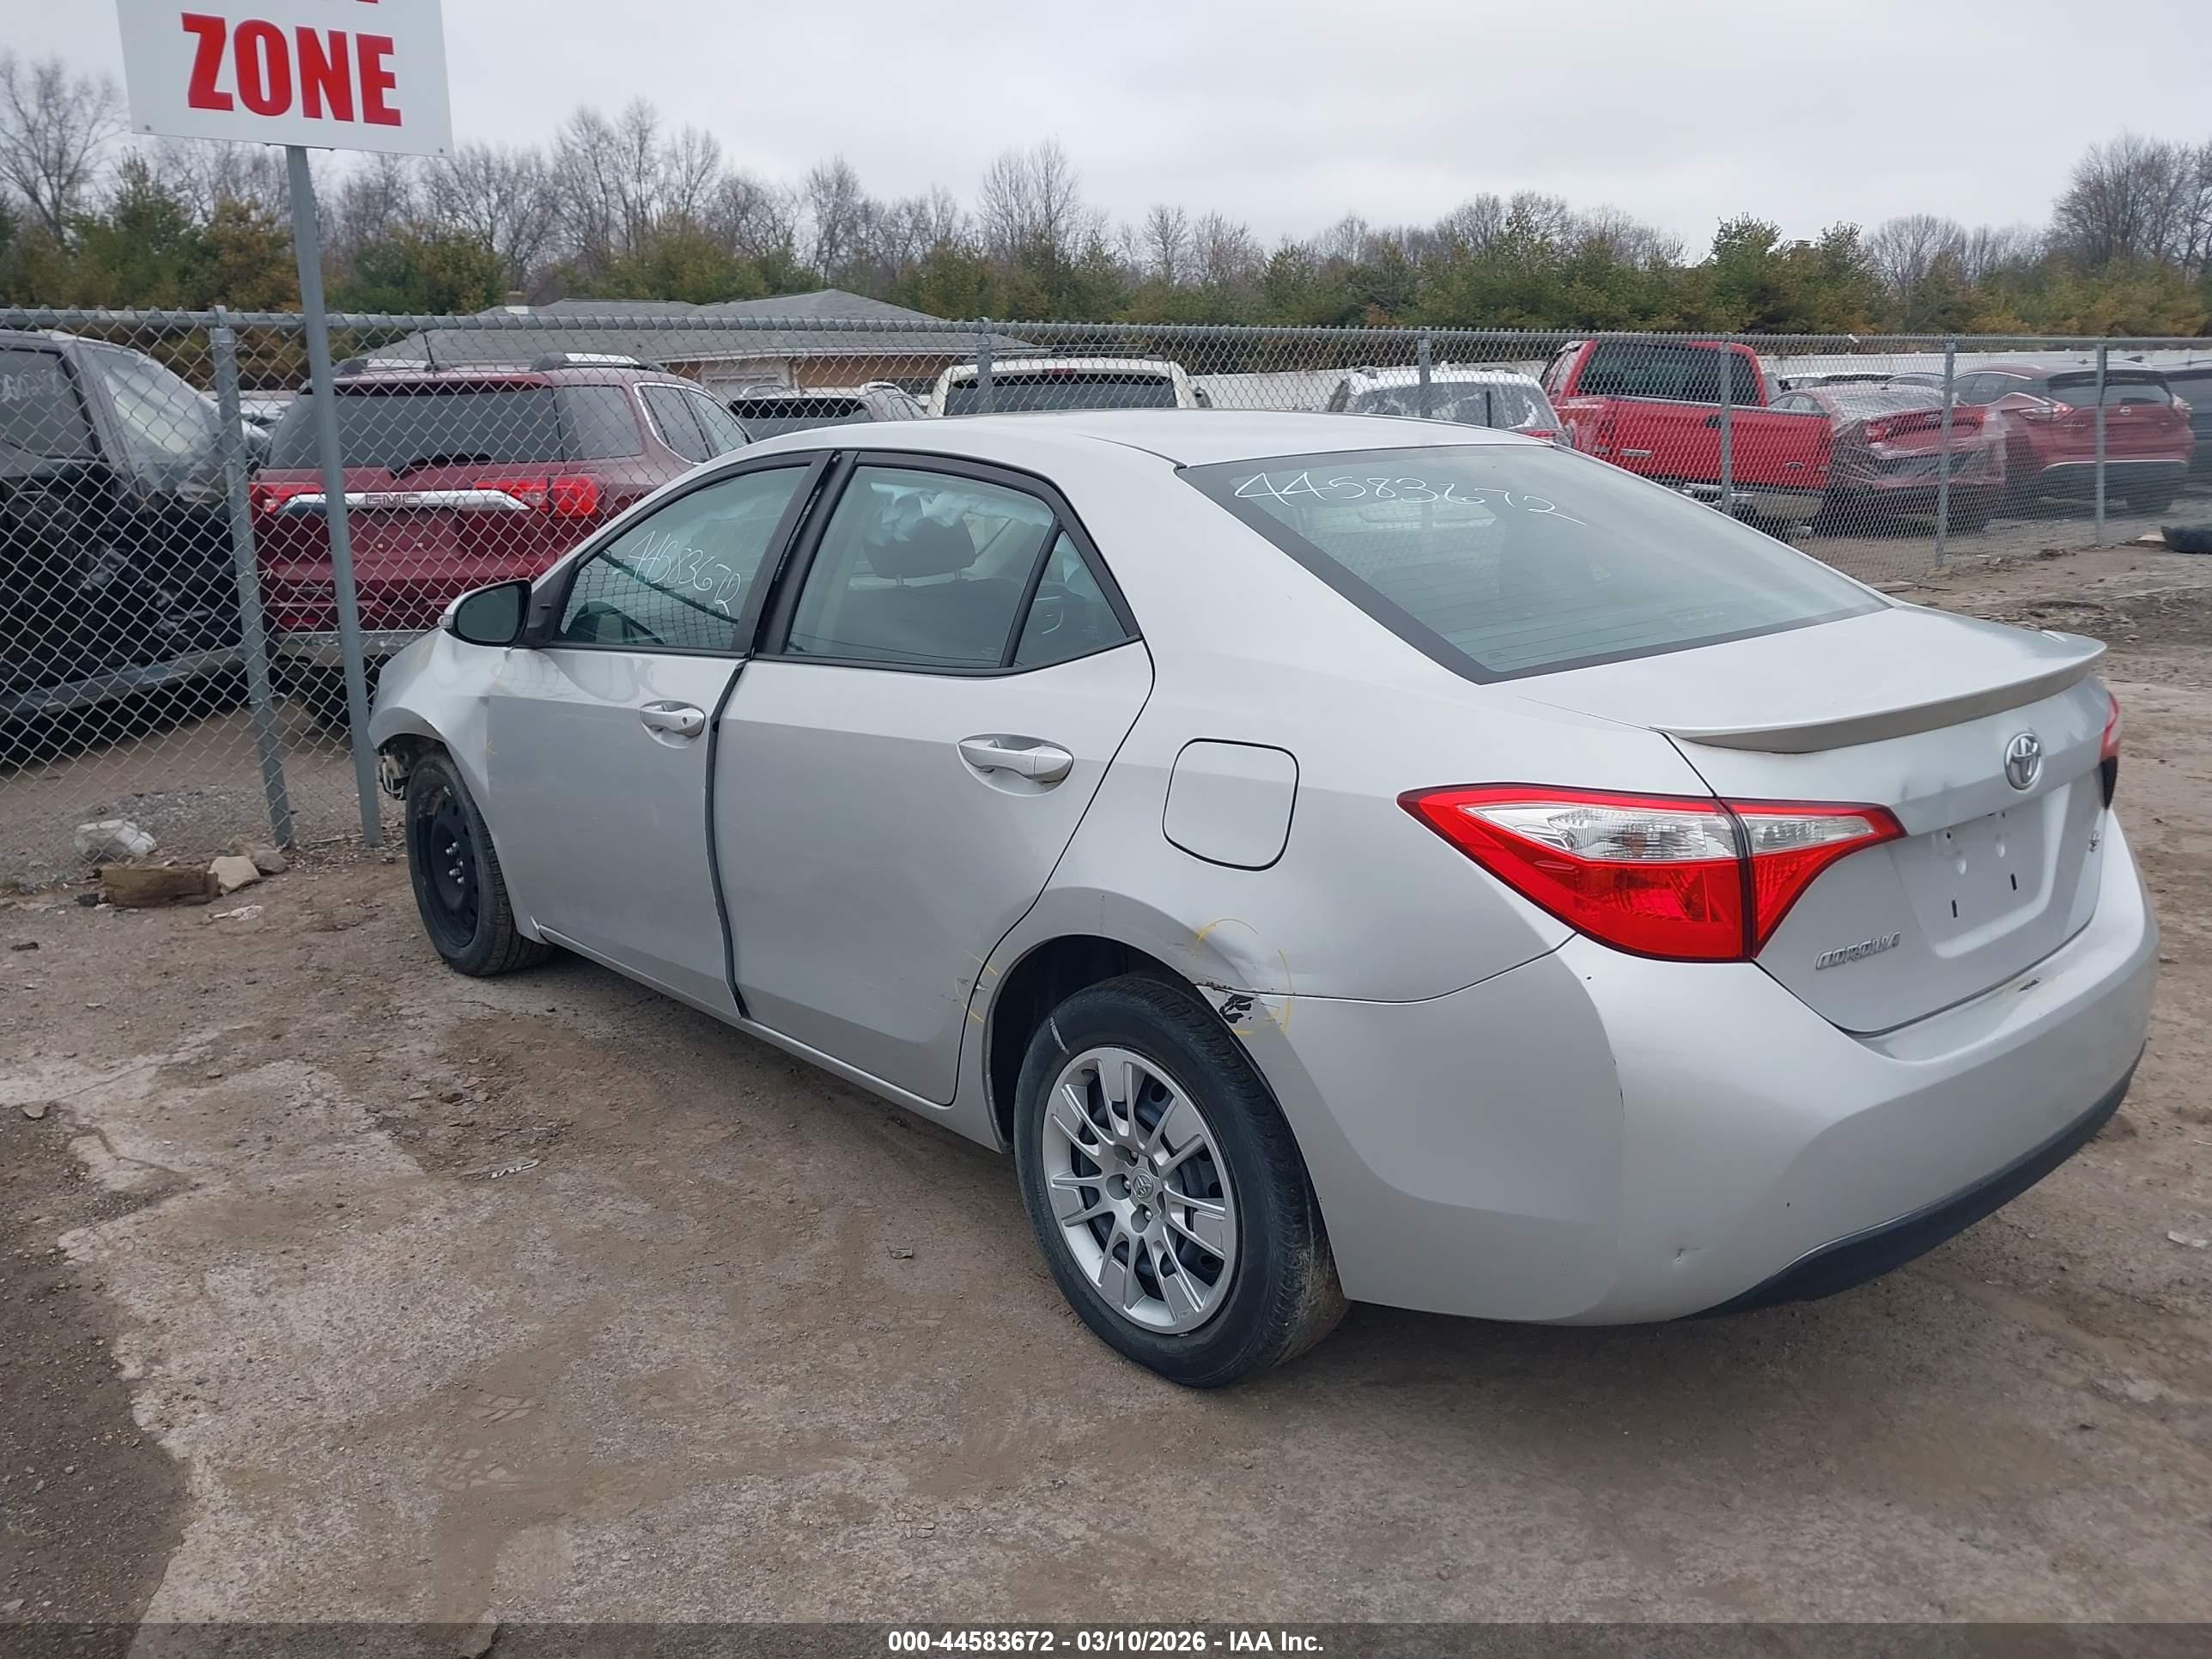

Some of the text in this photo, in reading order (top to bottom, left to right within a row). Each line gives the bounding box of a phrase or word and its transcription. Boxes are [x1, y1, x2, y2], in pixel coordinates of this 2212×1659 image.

[181, 12, 402, 127] ZONE
[366, 494, 421, 507] GMC
[1234, 471, 1588, 526] 44583672
